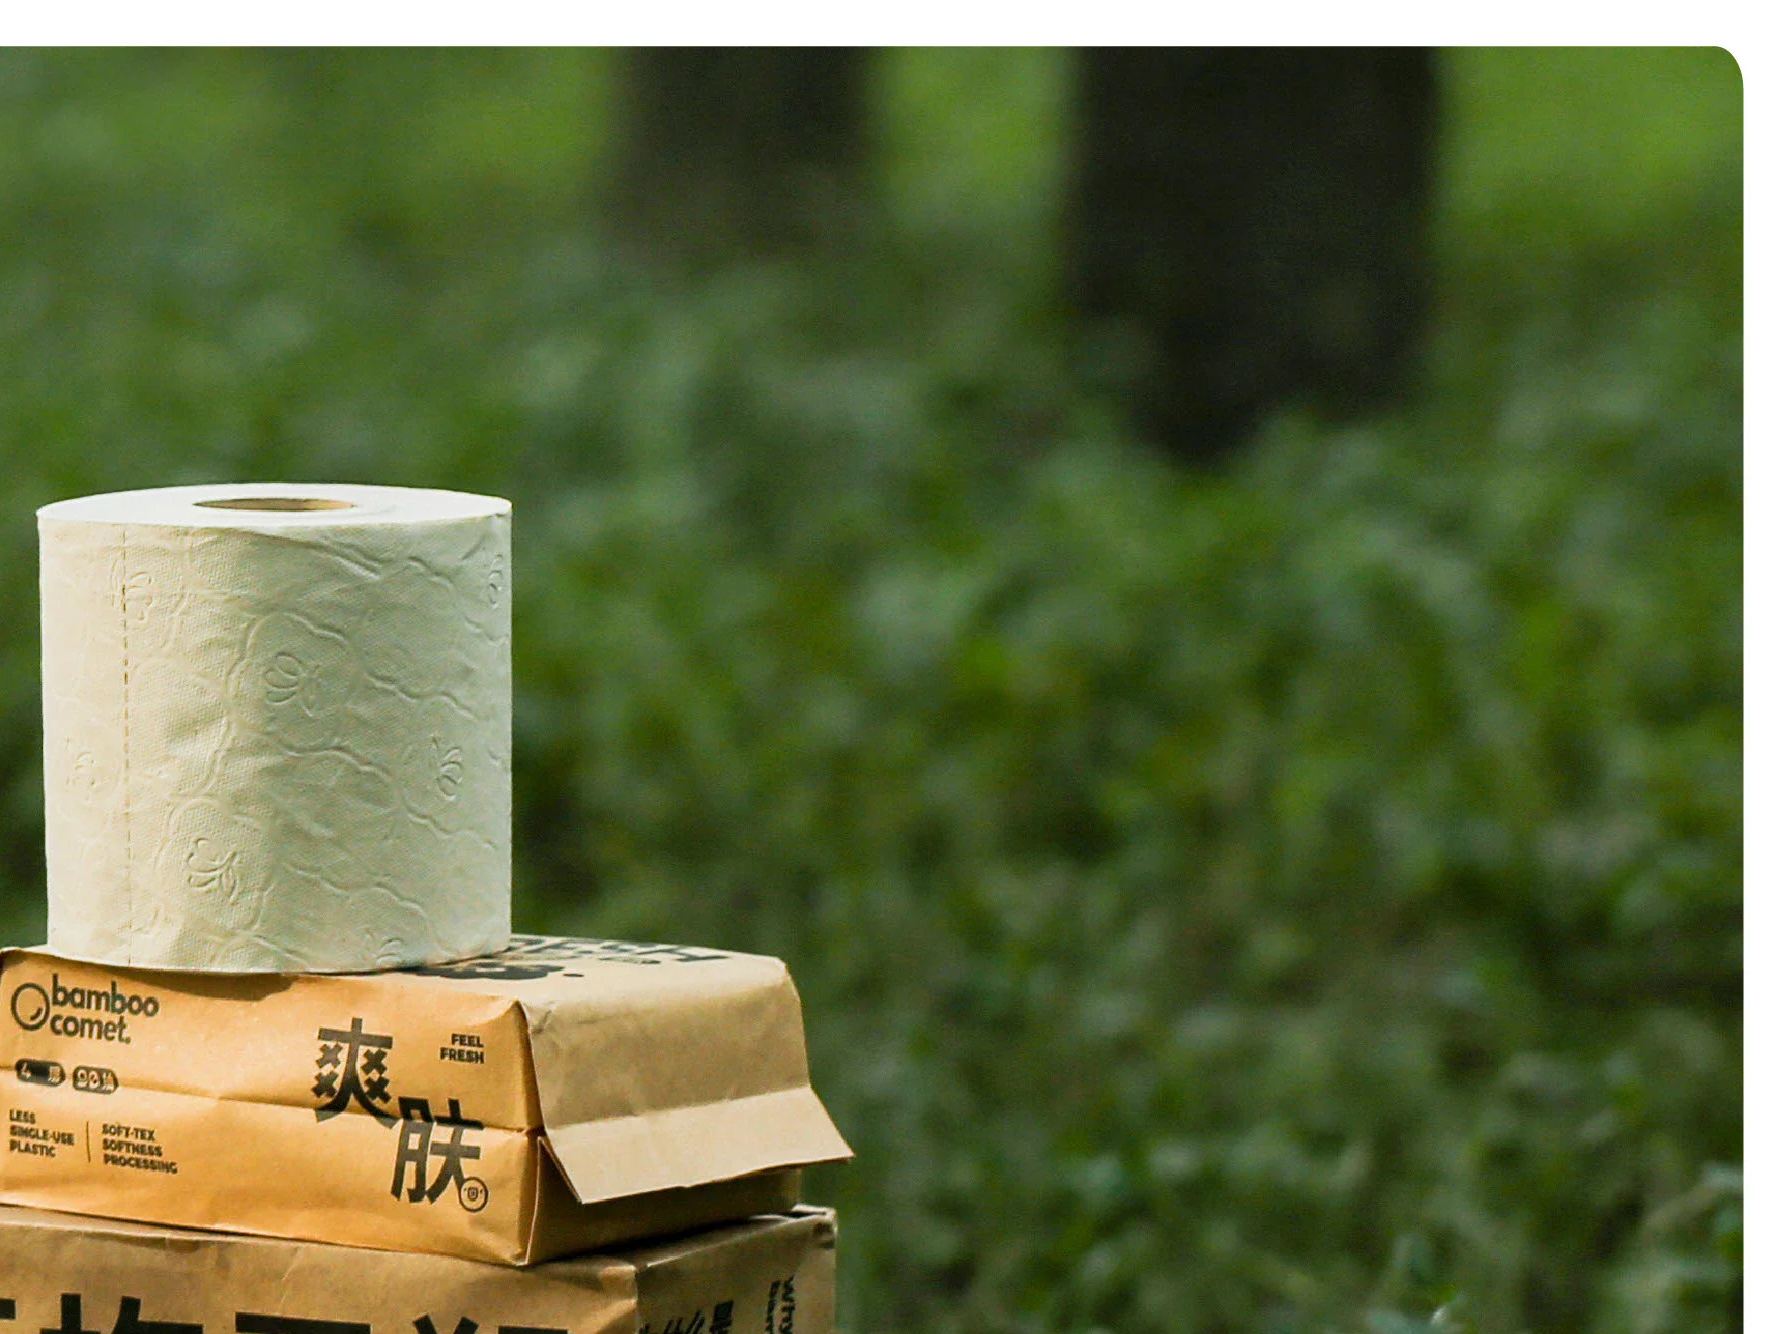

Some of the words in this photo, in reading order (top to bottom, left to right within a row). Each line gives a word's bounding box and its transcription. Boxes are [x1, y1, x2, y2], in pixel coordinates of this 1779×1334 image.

[51, 974, 160, 1018] bamboo
[50, 1013, 131, 1044] comet.
[450, 1032, 484, 1048] FEEL
[439, 1047, 485, 1064] FRESH
[9, 1109, 36, 1125] LESS
[9, 1125, 75, 1146] SINGLE-USE
[102, 1123, 155, 1142] SOFT-TEX
[9, 1140, 56, 1158] PLASTIC
[102, 1138, 162, 1157] SOFTNESS
[103, 1153, 178, 1174] PROCESSING
